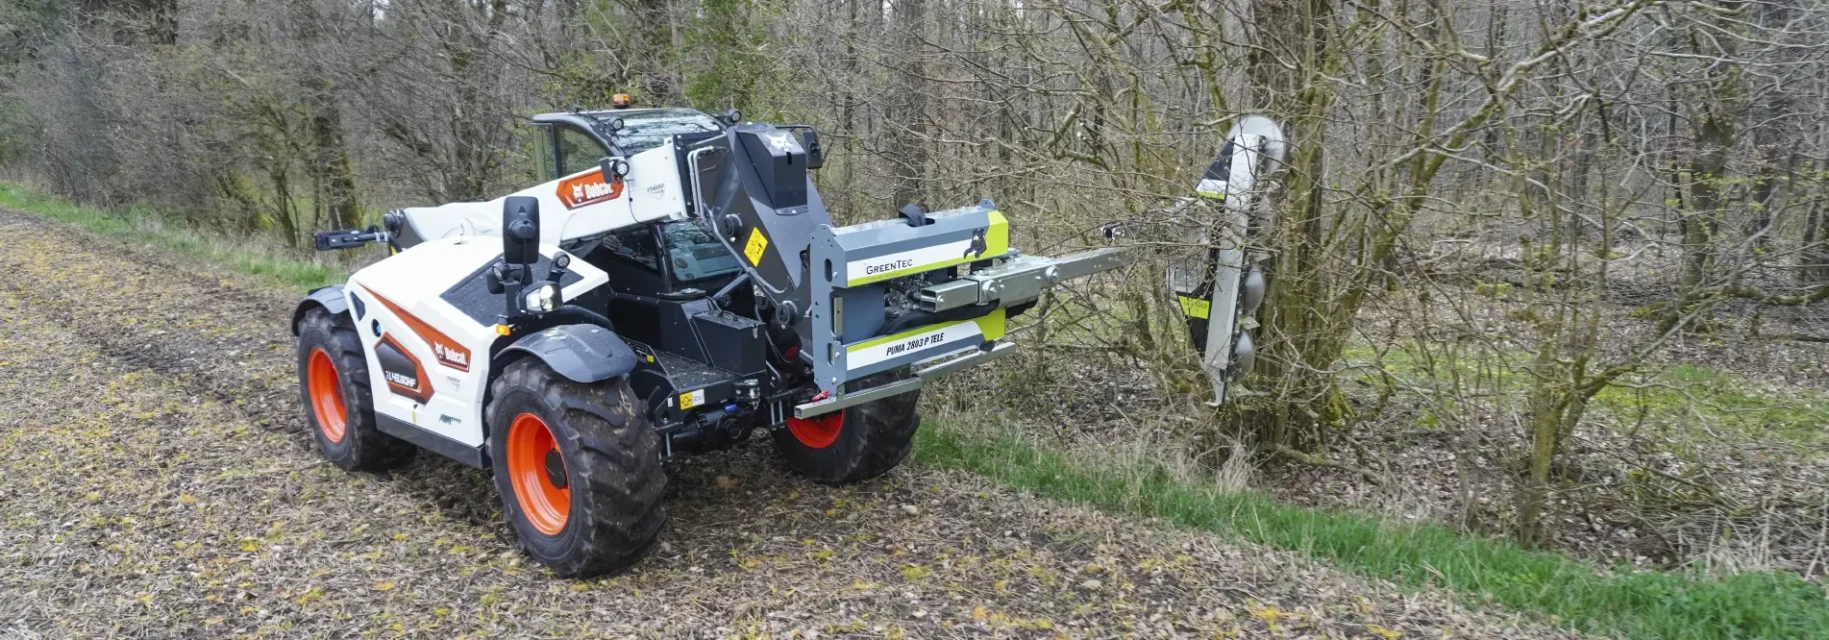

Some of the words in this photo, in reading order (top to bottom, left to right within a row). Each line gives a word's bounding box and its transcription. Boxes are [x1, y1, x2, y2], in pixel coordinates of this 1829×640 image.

[584, 182, 614, 200] Bobcat
[886, 343, 906, 356] PUMA
[906, 338, 925, 351] 2803
[924, 336, 930, 346] P
[930, 332, 945, 344] TELE
[444, 346, 468, 366] Bobcat
